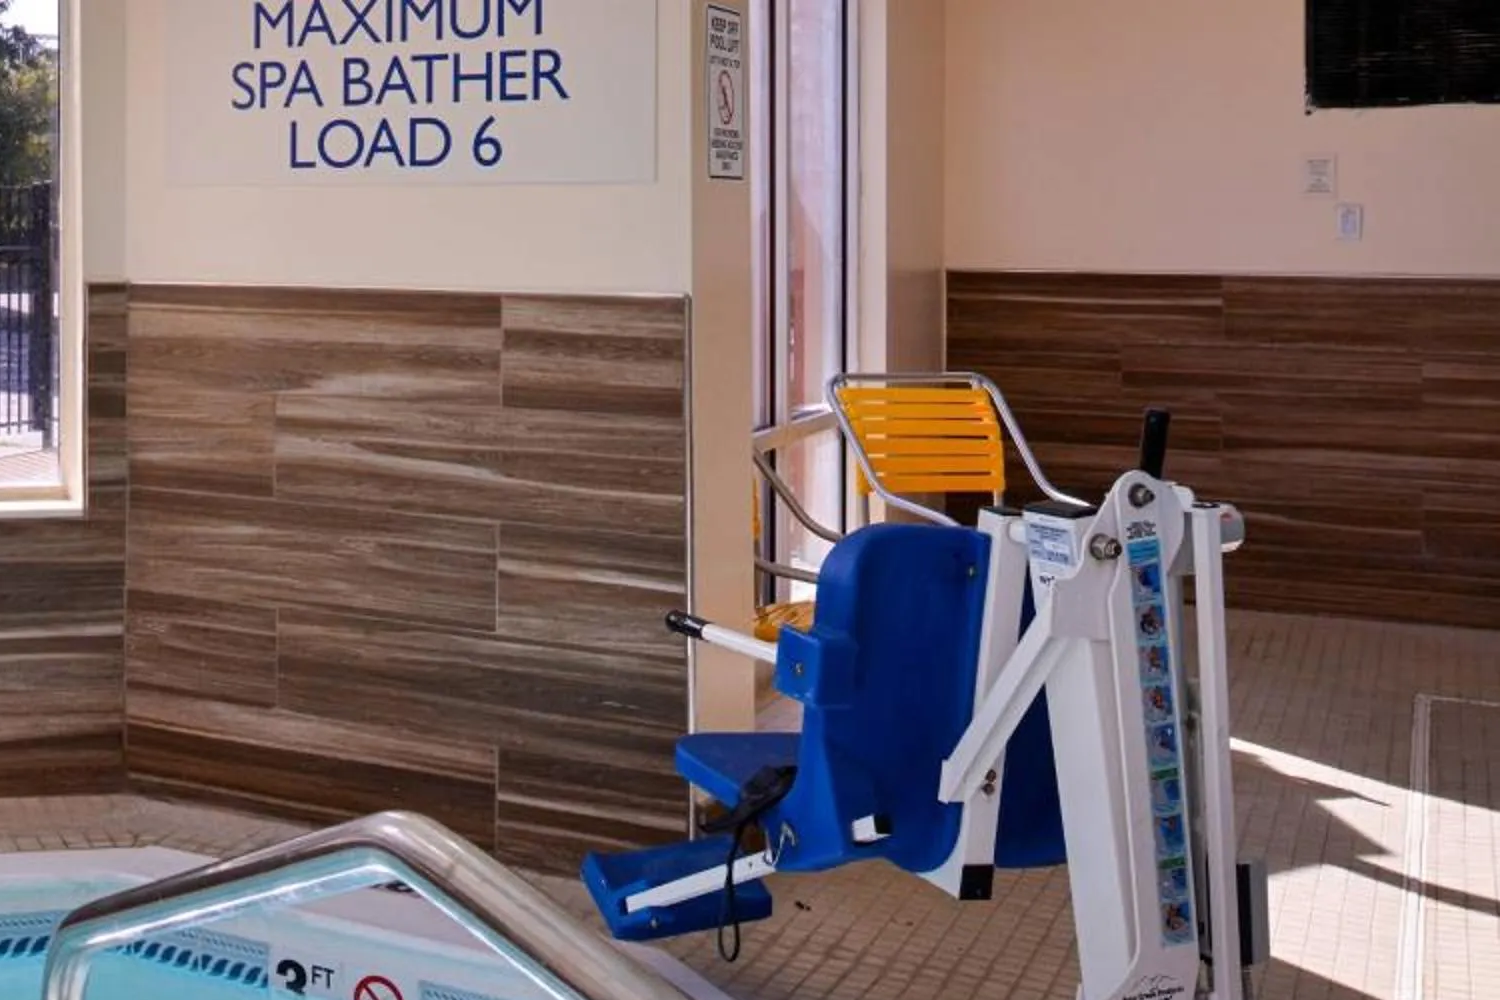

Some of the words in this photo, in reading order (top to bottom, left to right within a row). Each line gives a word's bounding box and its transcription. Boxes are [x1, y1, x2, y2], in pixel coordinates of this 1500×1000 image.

[253, 0, 543, 49] MAXIMUM
[231, 59, 324, 110] SPA
[343, 49, 571, 106] BATHER
[290, 117, 452, 169] LOAD
[473, 115, 503, 167] 6
[311, 965, 335, 990] FT
